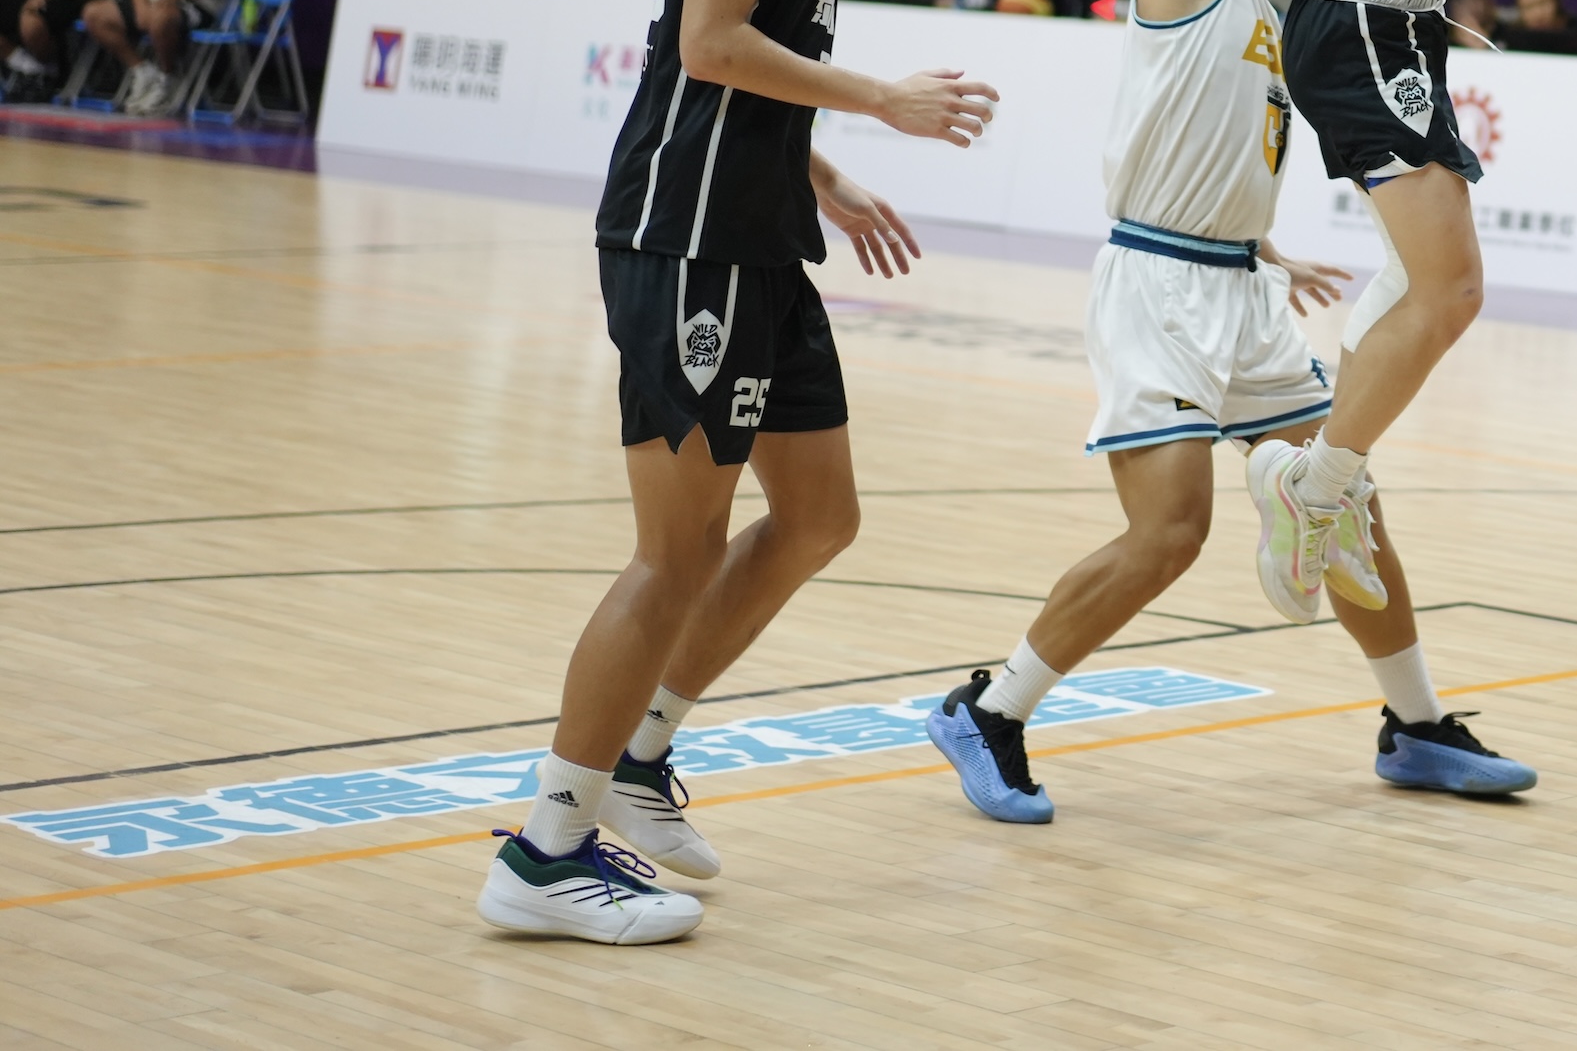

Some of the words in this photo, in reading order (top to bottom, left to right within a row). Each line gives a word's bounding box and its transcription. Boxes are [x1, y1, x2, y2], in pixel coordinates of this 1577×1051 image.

[692, 323, 718, 334] WILD
[682, 354, 720, 368] BLACK
[547, 794, 580, 808] adidas
